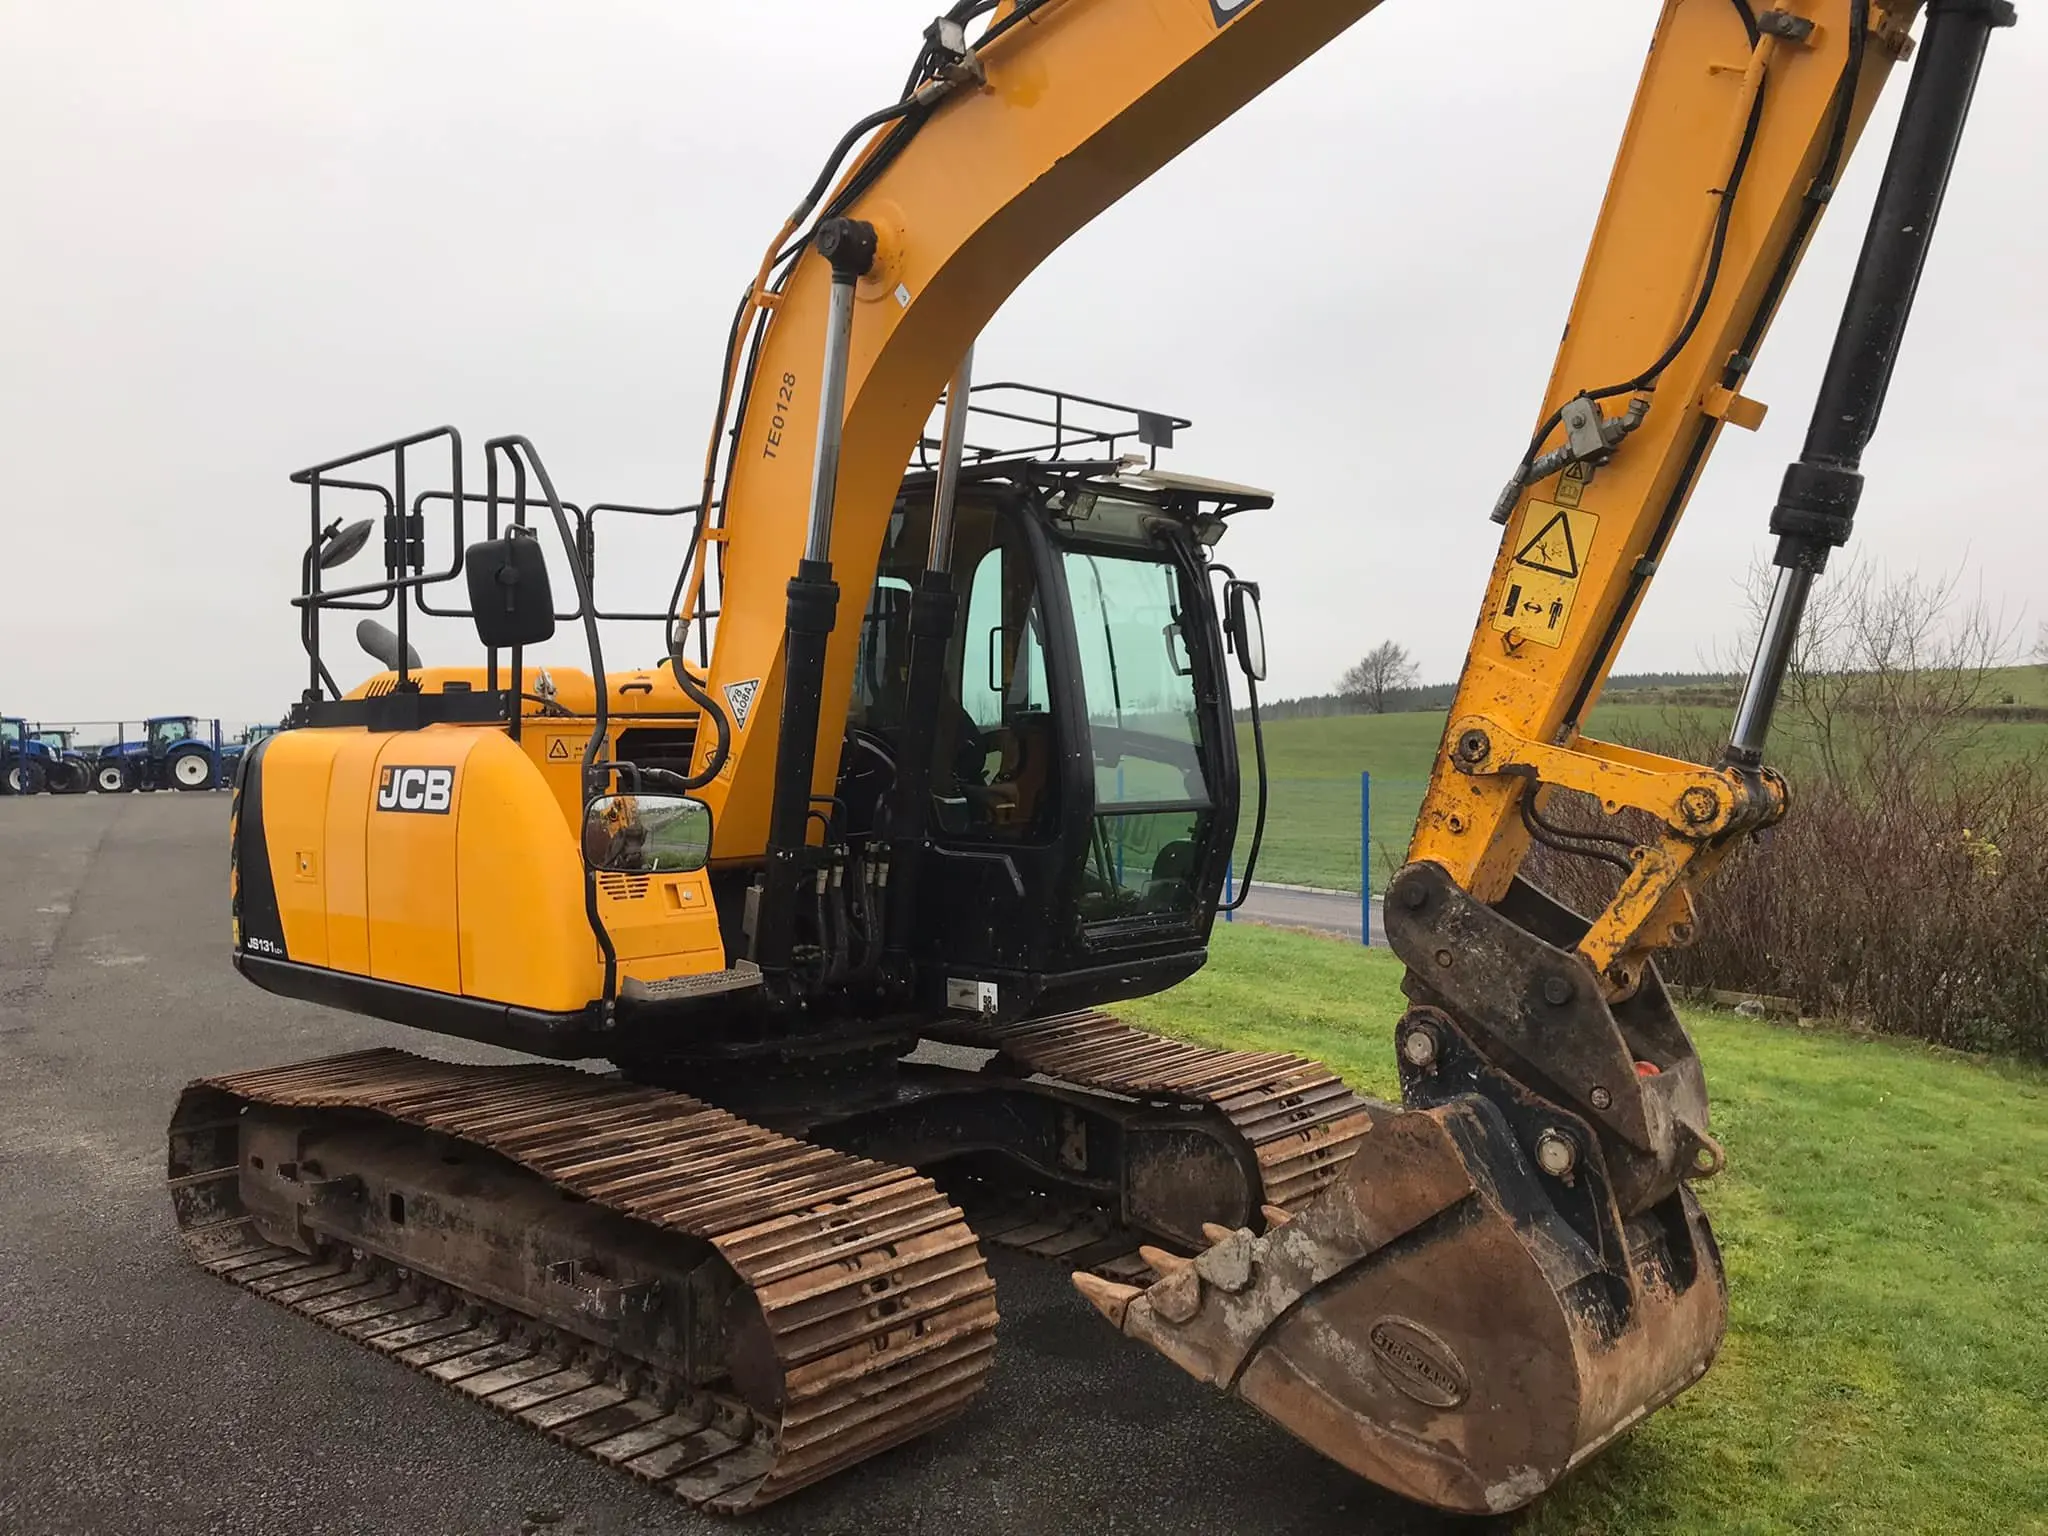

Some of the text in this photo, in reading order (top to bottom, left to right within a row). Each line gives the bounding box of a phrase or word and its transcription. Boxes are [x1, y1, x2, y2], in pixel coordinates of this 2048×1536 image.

[762, 372, 797, 460] TE0128
[731, 688, 743, 704] 78
[378, 768, 453, 811] JCB
[247, 936, 274, 953] JS131
[1374, 1329, 1458, 1396] STRICKLAND
